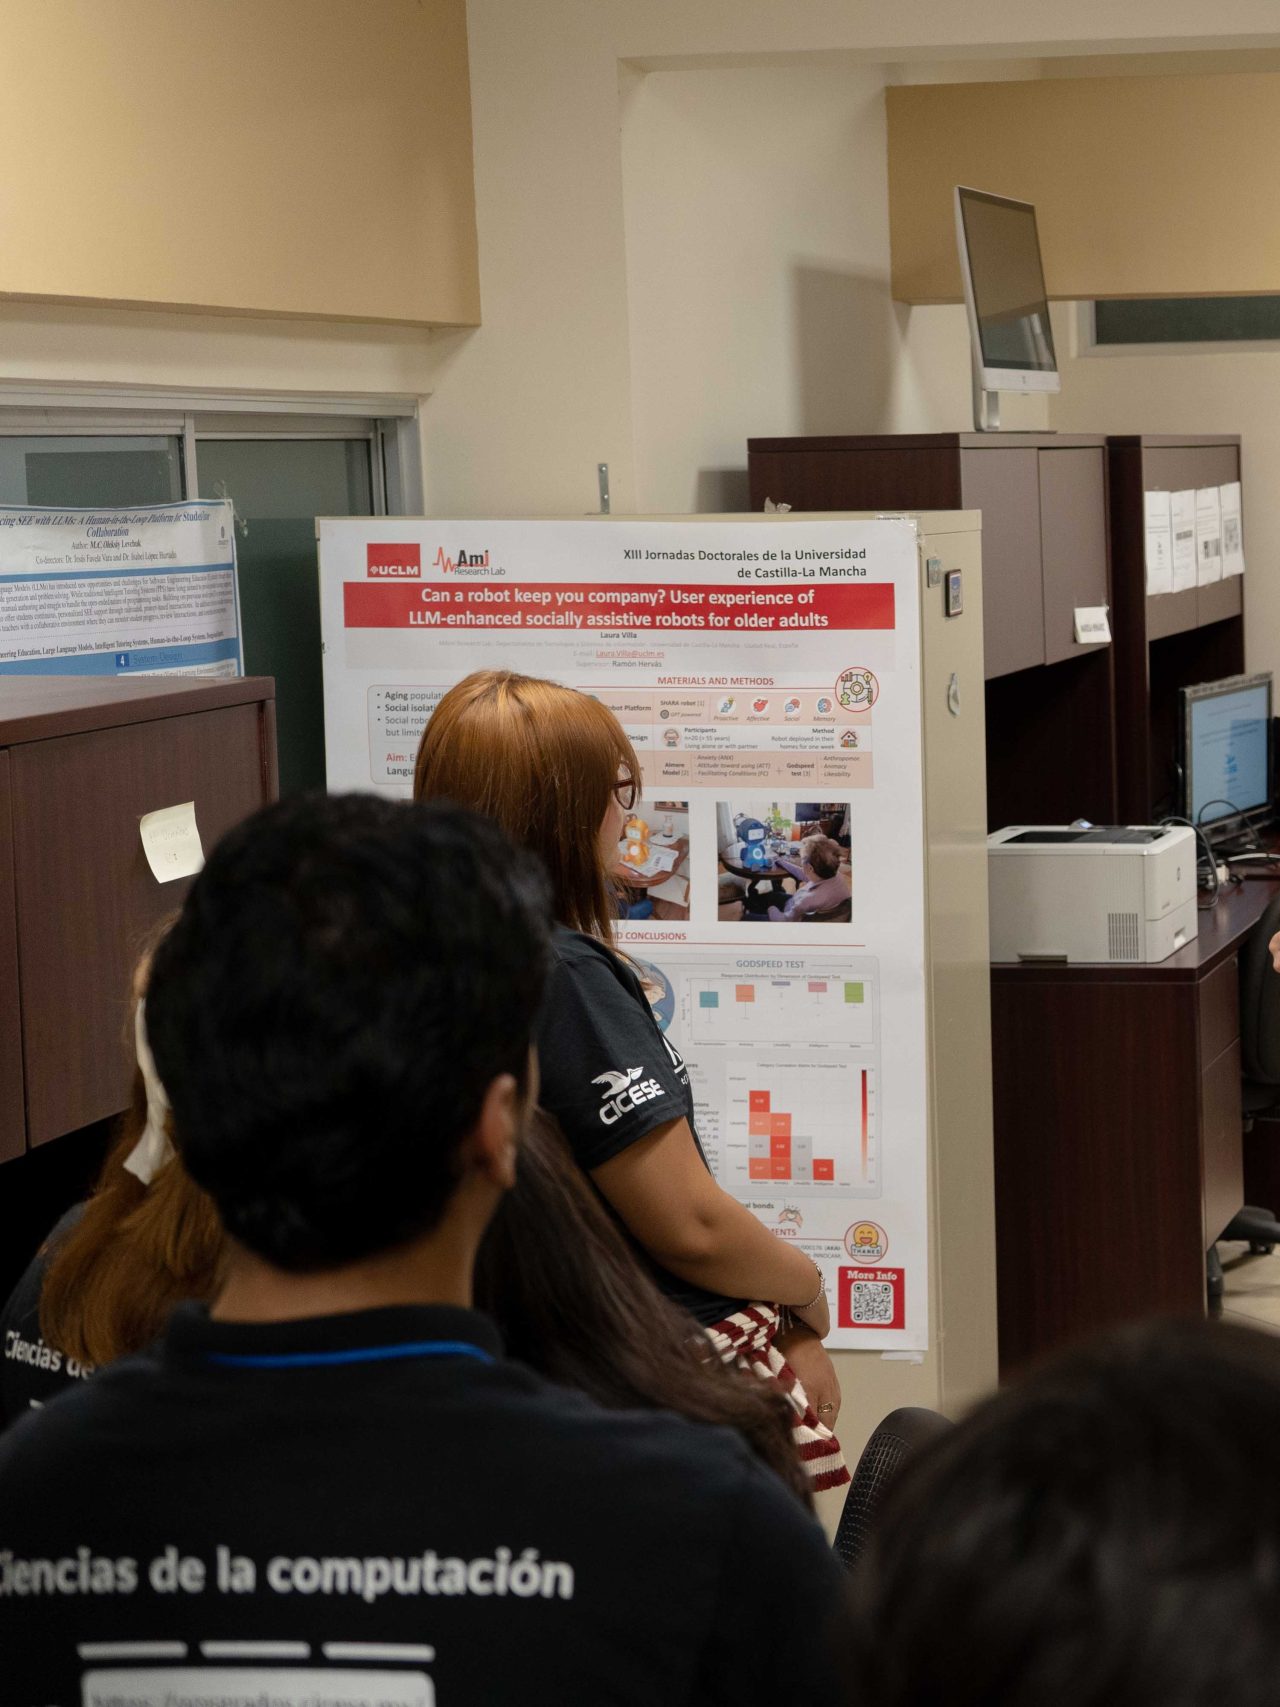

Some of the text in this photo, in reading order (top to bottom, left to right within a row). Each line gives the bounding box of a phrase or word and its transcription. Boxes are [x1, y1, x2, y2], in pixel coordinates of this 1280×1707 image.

[16, 514, 35, 525] SEE
[86, 526, 129, 537] Collaboration
[623, 548, 866, 561] XIII Jornadas Doctorales de la Universidad
[379, 564, 419, 576] UCLM
[454, 567, 506, 577] Research Lab
[737, 566, 867, 578] de Castilla-La Mancha
[421, 588, 815, 608] Can a robot keep you company? User experience of
[408, 611, 829, 629] LLM-enhanced socially assistive robots for older adults
[600, 631, 637, 639] Laura Villa
[612, 659, 636, 668] Ramón
[638, 659, 662, 668] Hervás
[657, 676, 774, 686] MATERIALS AND METHODS
[384, 691, 409, 701] Aging
[384, 704, 409, 712] Social
[624, 704, 652, 712] Platform
[385, 716, 409, 725] Social
[386, 728, 400, 737] but
[684, 727, 717, 735] Participants
[386, 753, 408, 762] Aim:
[786, 763, 815, 771] Godspeed
[625, 932, 687, 942] CONCLUSIONS
[735, 959, 806, 969] GODSPEED TEST
[599, 1078, 666, 1125] CICESE
[752, 1202, 775, 1210] bonds
[847, 1270, 898, 1281] More Info
[0, 1544, 575, 1603] iencias de la computación
